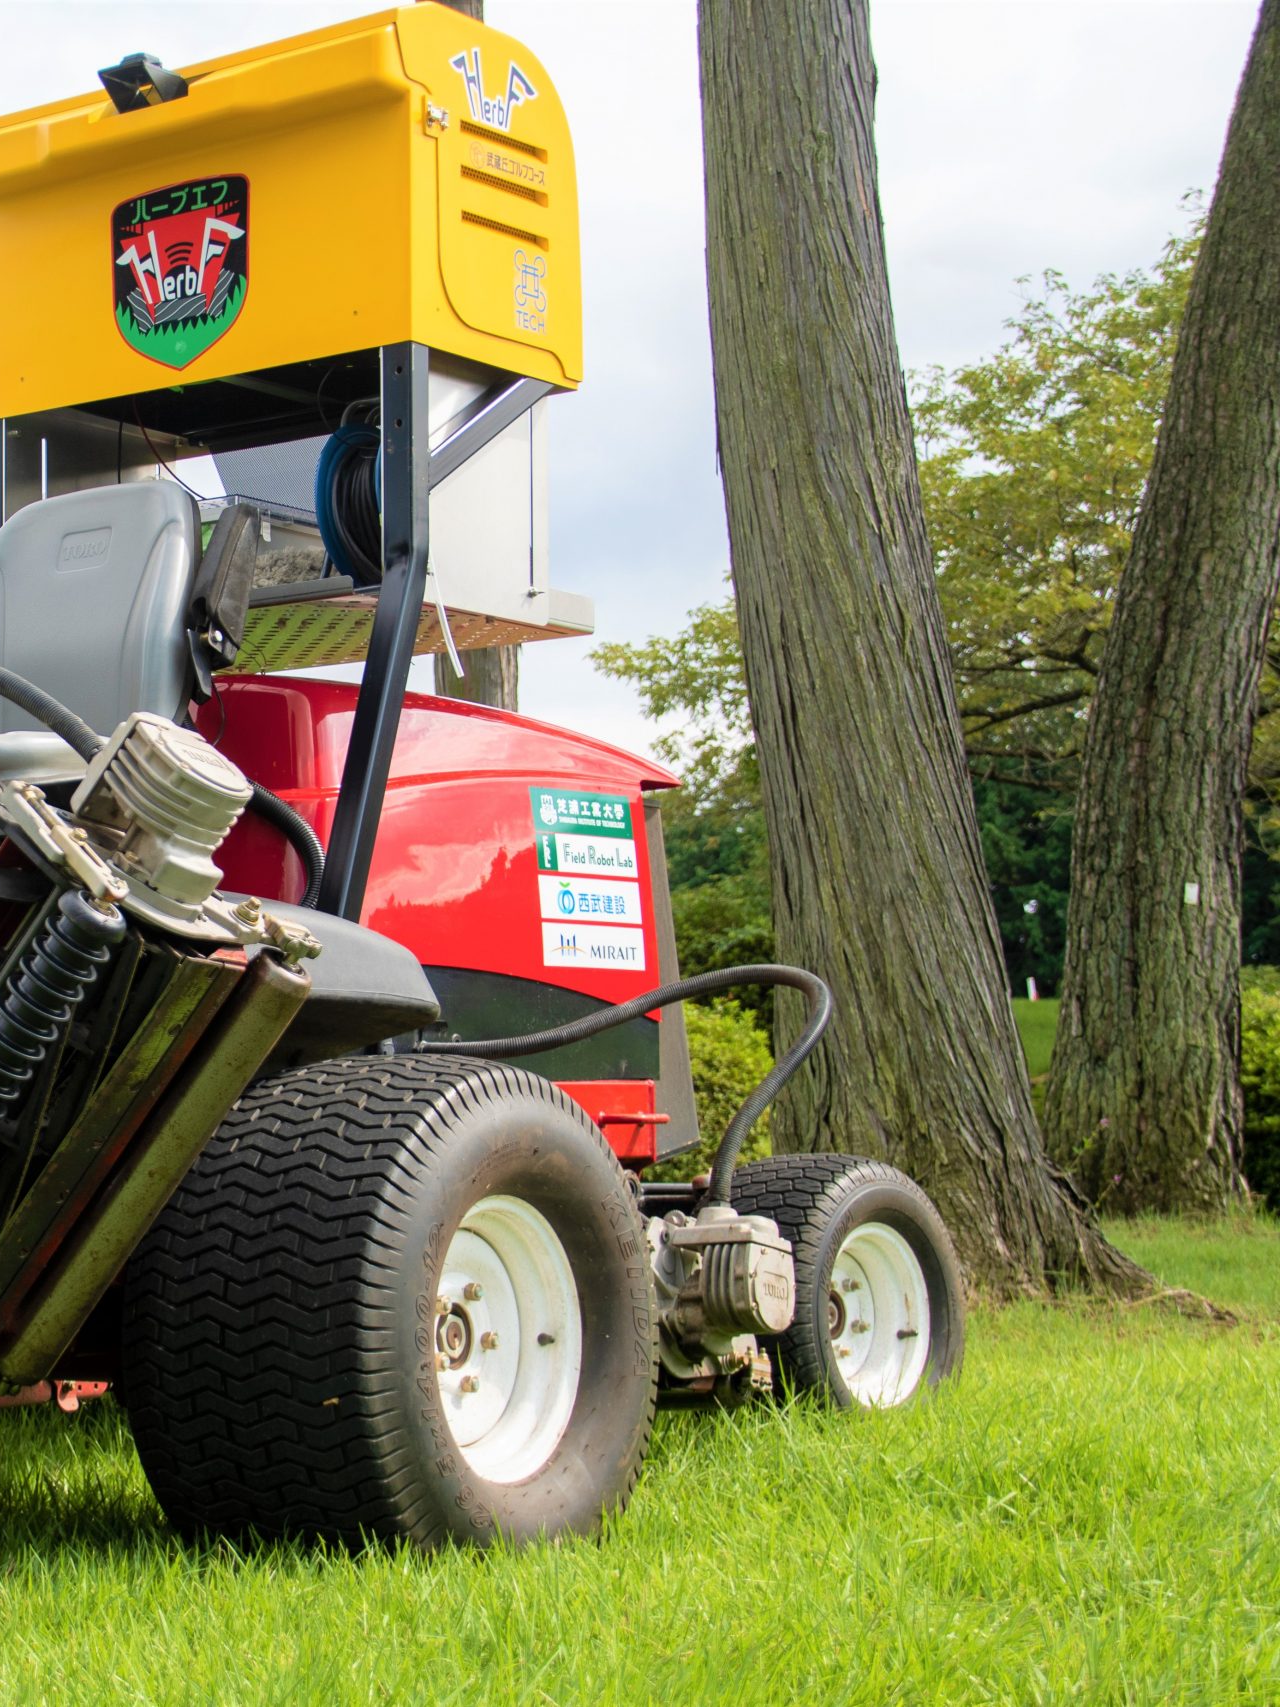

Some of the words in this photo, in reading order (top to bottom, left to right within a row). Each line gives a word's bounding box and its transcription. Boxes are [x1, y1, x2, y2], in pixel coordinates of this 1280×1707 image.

[131, 180, 229, 225] ハーブエフ
[516, 309, 546, 334] TECH
[63, 541, 107, 561] TORO
[563, 842, 586, 865] Field
[587, 845, 615, 867] Robot
[616, 847, 633, 868] Lab
[578, 892, 626, 915] 西武建設
[590, 944, 637, 961] MIRAIT
